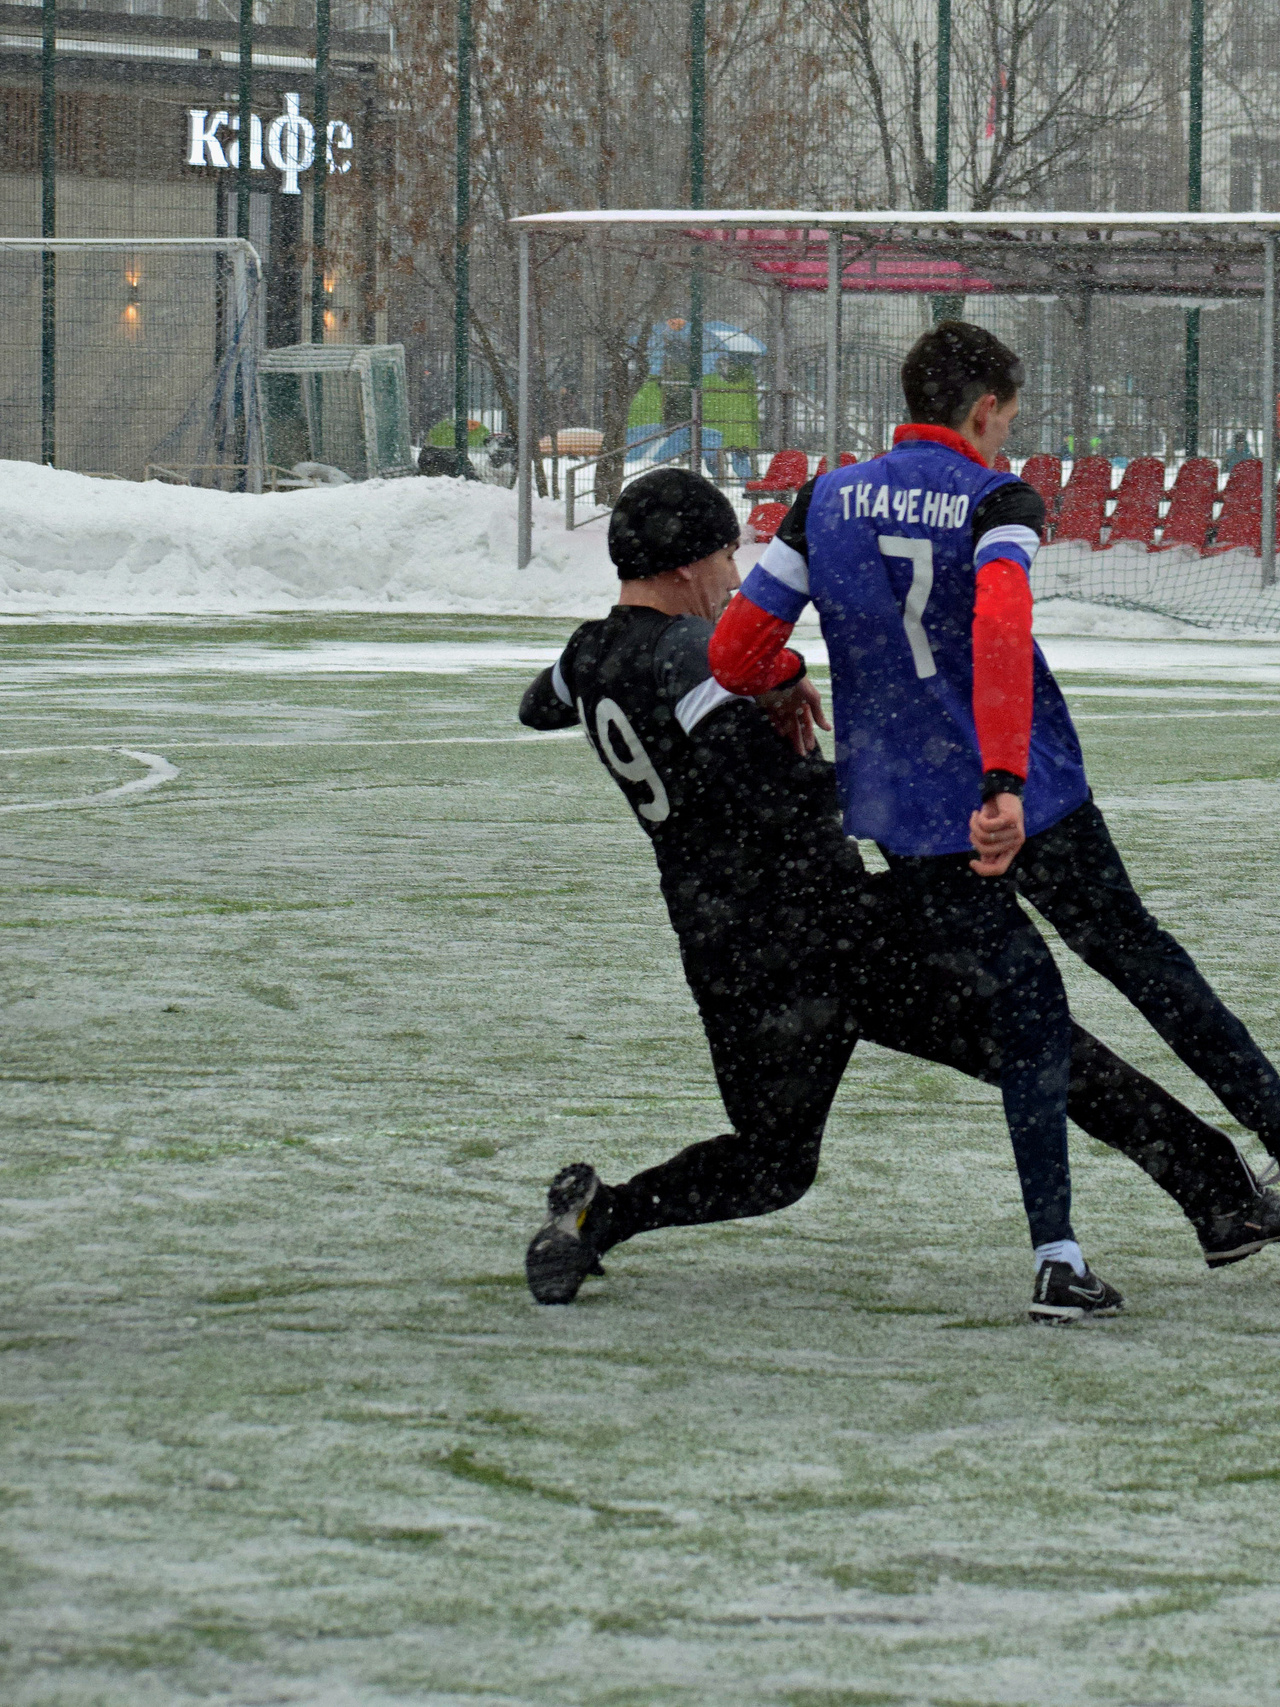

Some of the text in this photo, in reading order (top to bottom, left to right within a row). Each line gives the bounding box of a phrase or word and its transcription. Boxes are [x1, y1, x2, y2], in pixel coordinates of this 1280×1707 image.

[188, 92, 353, 194] кафе
[839, 483, 970, 529] ТКАЧЕНКО
[878, 535, 937, 679] 7
